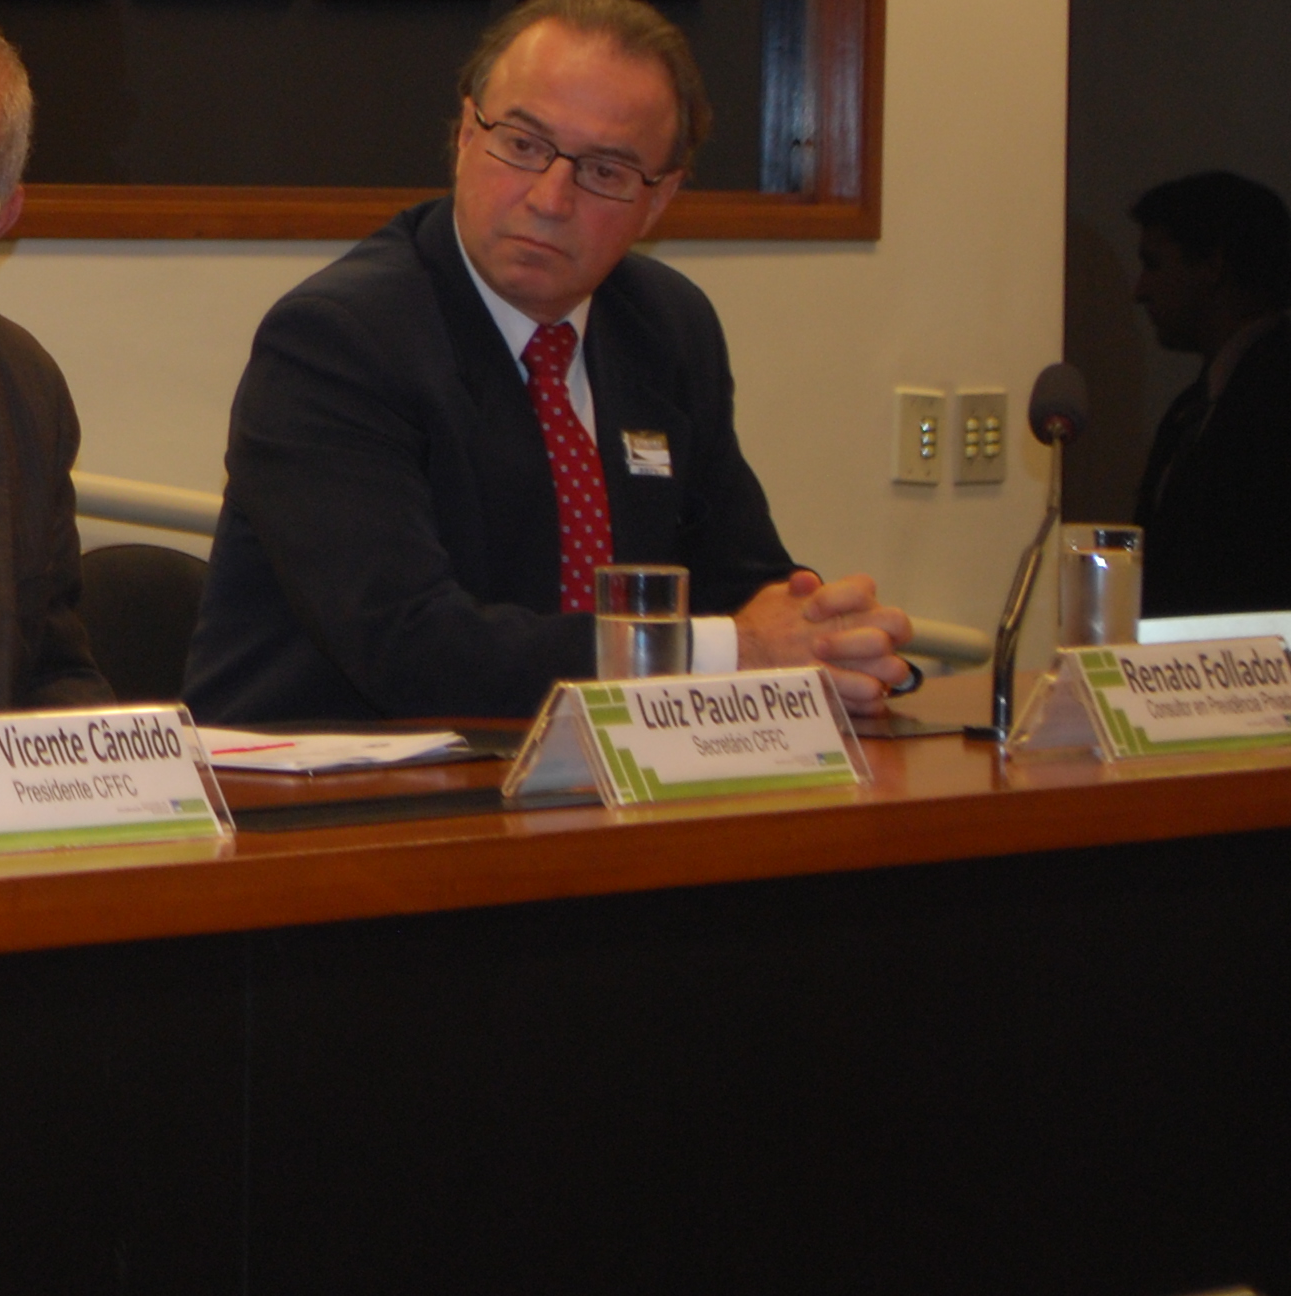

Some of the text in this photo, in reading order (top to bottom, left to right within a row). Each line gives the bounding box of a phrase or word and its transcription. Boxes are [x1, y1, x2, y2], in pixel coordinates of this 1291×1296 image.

[1120, 647, 1288, 694] Renato Follador
[635, 679, 820, 730] Luiz Paulo Pieri
[87, 715, 182, 762] Cândido
[753, 729, 790, 753] CFFC
[12, 774, 138, 804] Presidente CFFC
